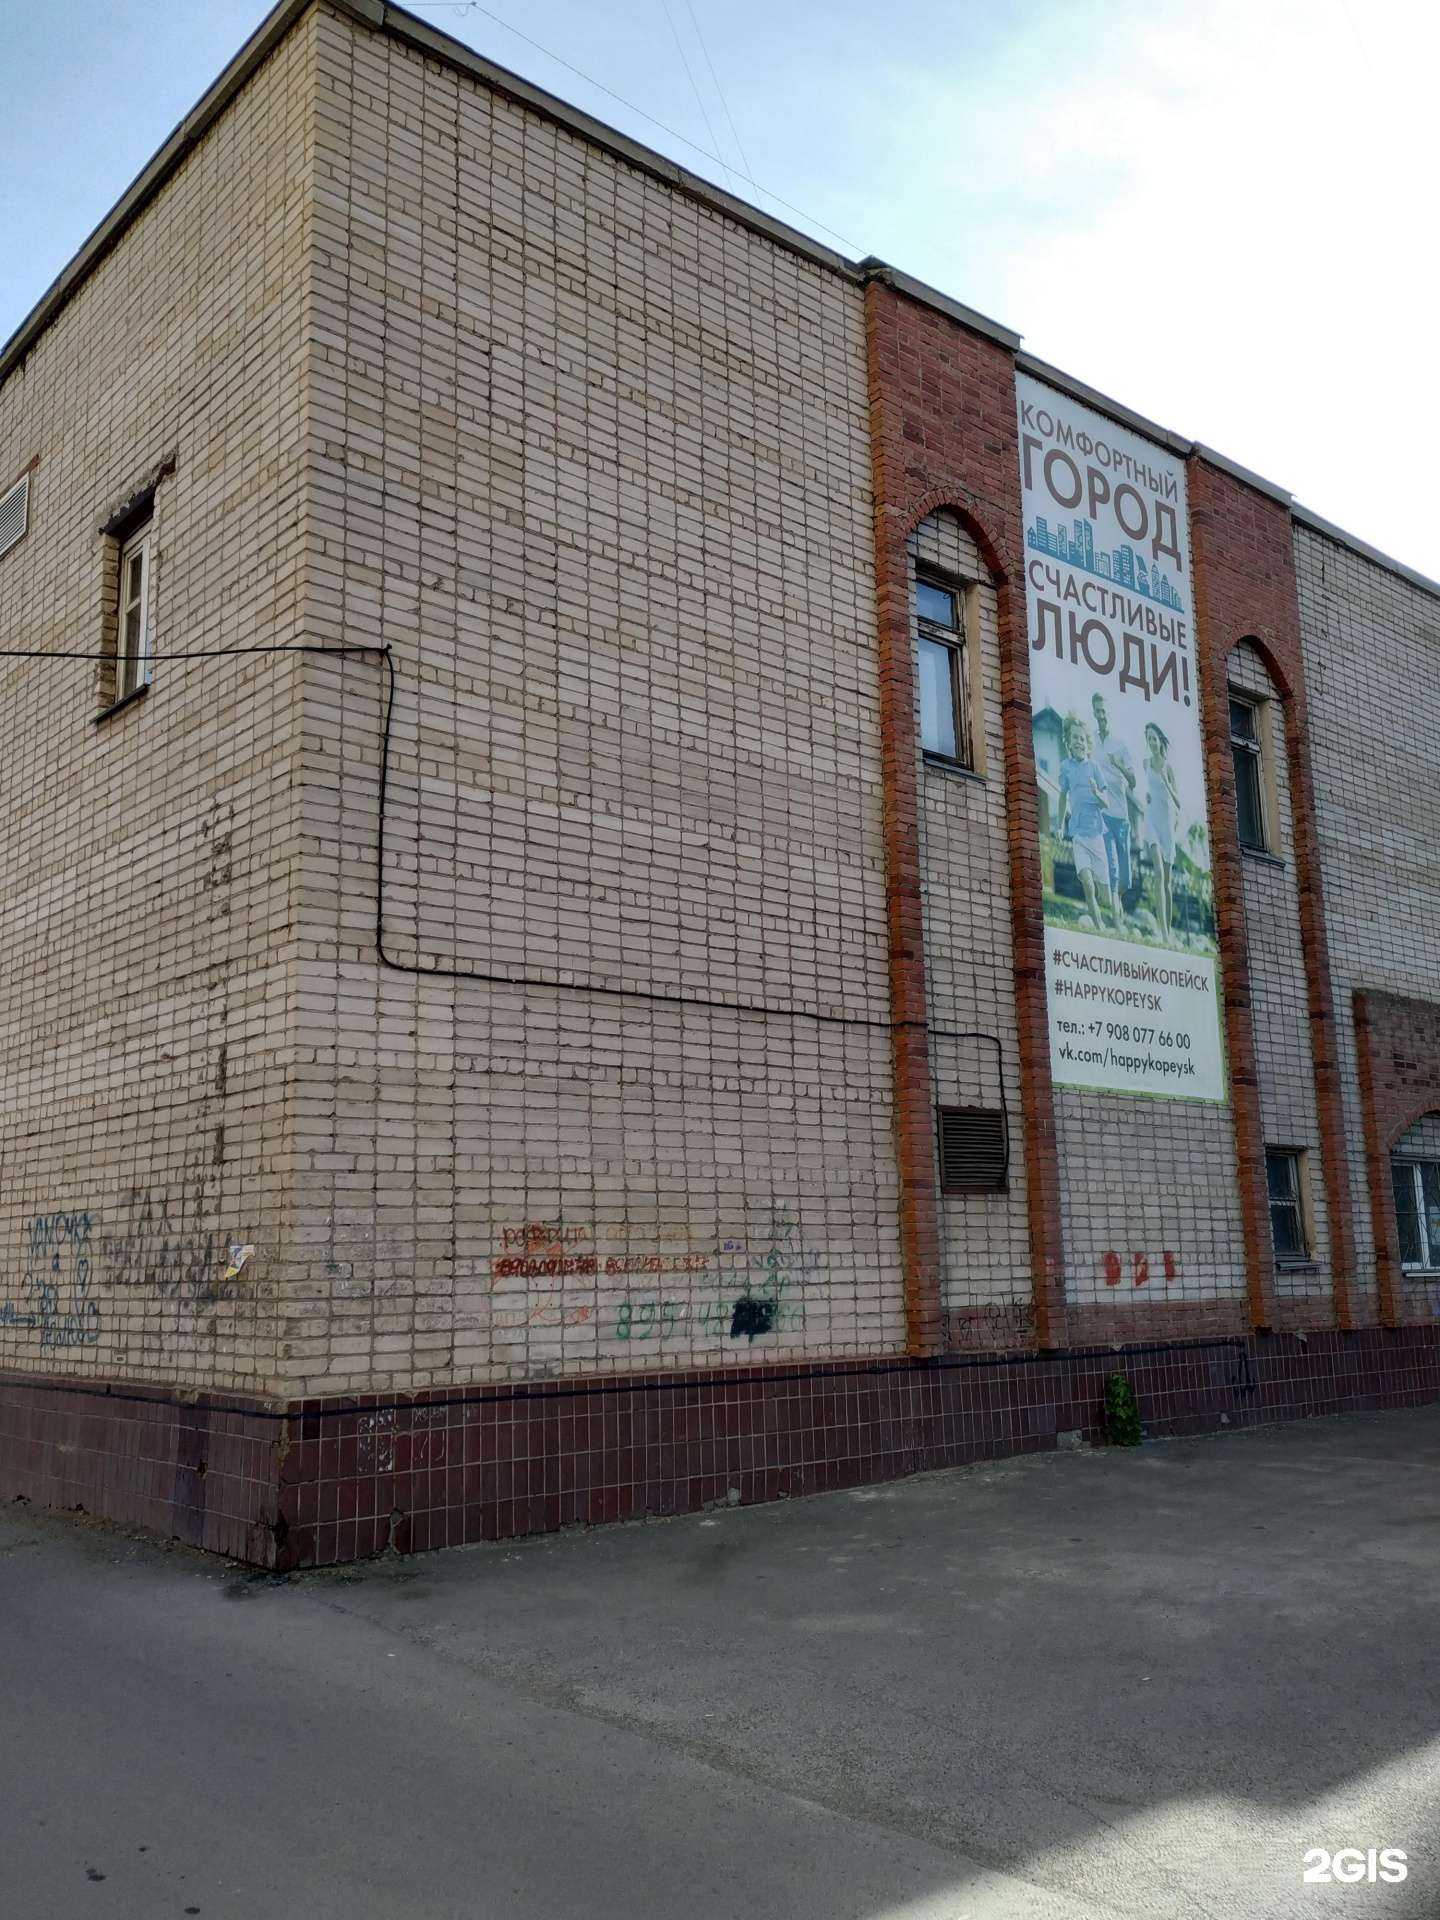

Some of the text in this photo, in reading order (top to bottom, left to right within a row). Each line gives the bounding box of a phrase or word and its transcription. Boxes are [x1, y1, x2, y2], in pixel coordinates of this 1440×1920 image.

[1021, 400, 1178, 503] КОМФОРТНЫЙ
[1022, 434, 1182, 573] ГОРОД
[1028, 560, 1187, 650] СЧАСТЛИВЫЕ
[1032, 599, 1191, 707] ЛЮДИ!
[1053, 948, 1209, 992] #СЧАСТЛИВЫЙКОПЕЙСК
[1055, 979, 1162, 1011] #HAPPYKOPEYSK
[1059, 1041, 1195, 1077] vk.com/happykopeysk
[1088, 1021, 1102, 1037] +7
[1106, 1022, 1129, 1041] 908
[1133, 1026, 1155, 1045] 077
[1158, 1030, 1173, 1047] 66
[1176, 1033, 1190, 1050] 00
